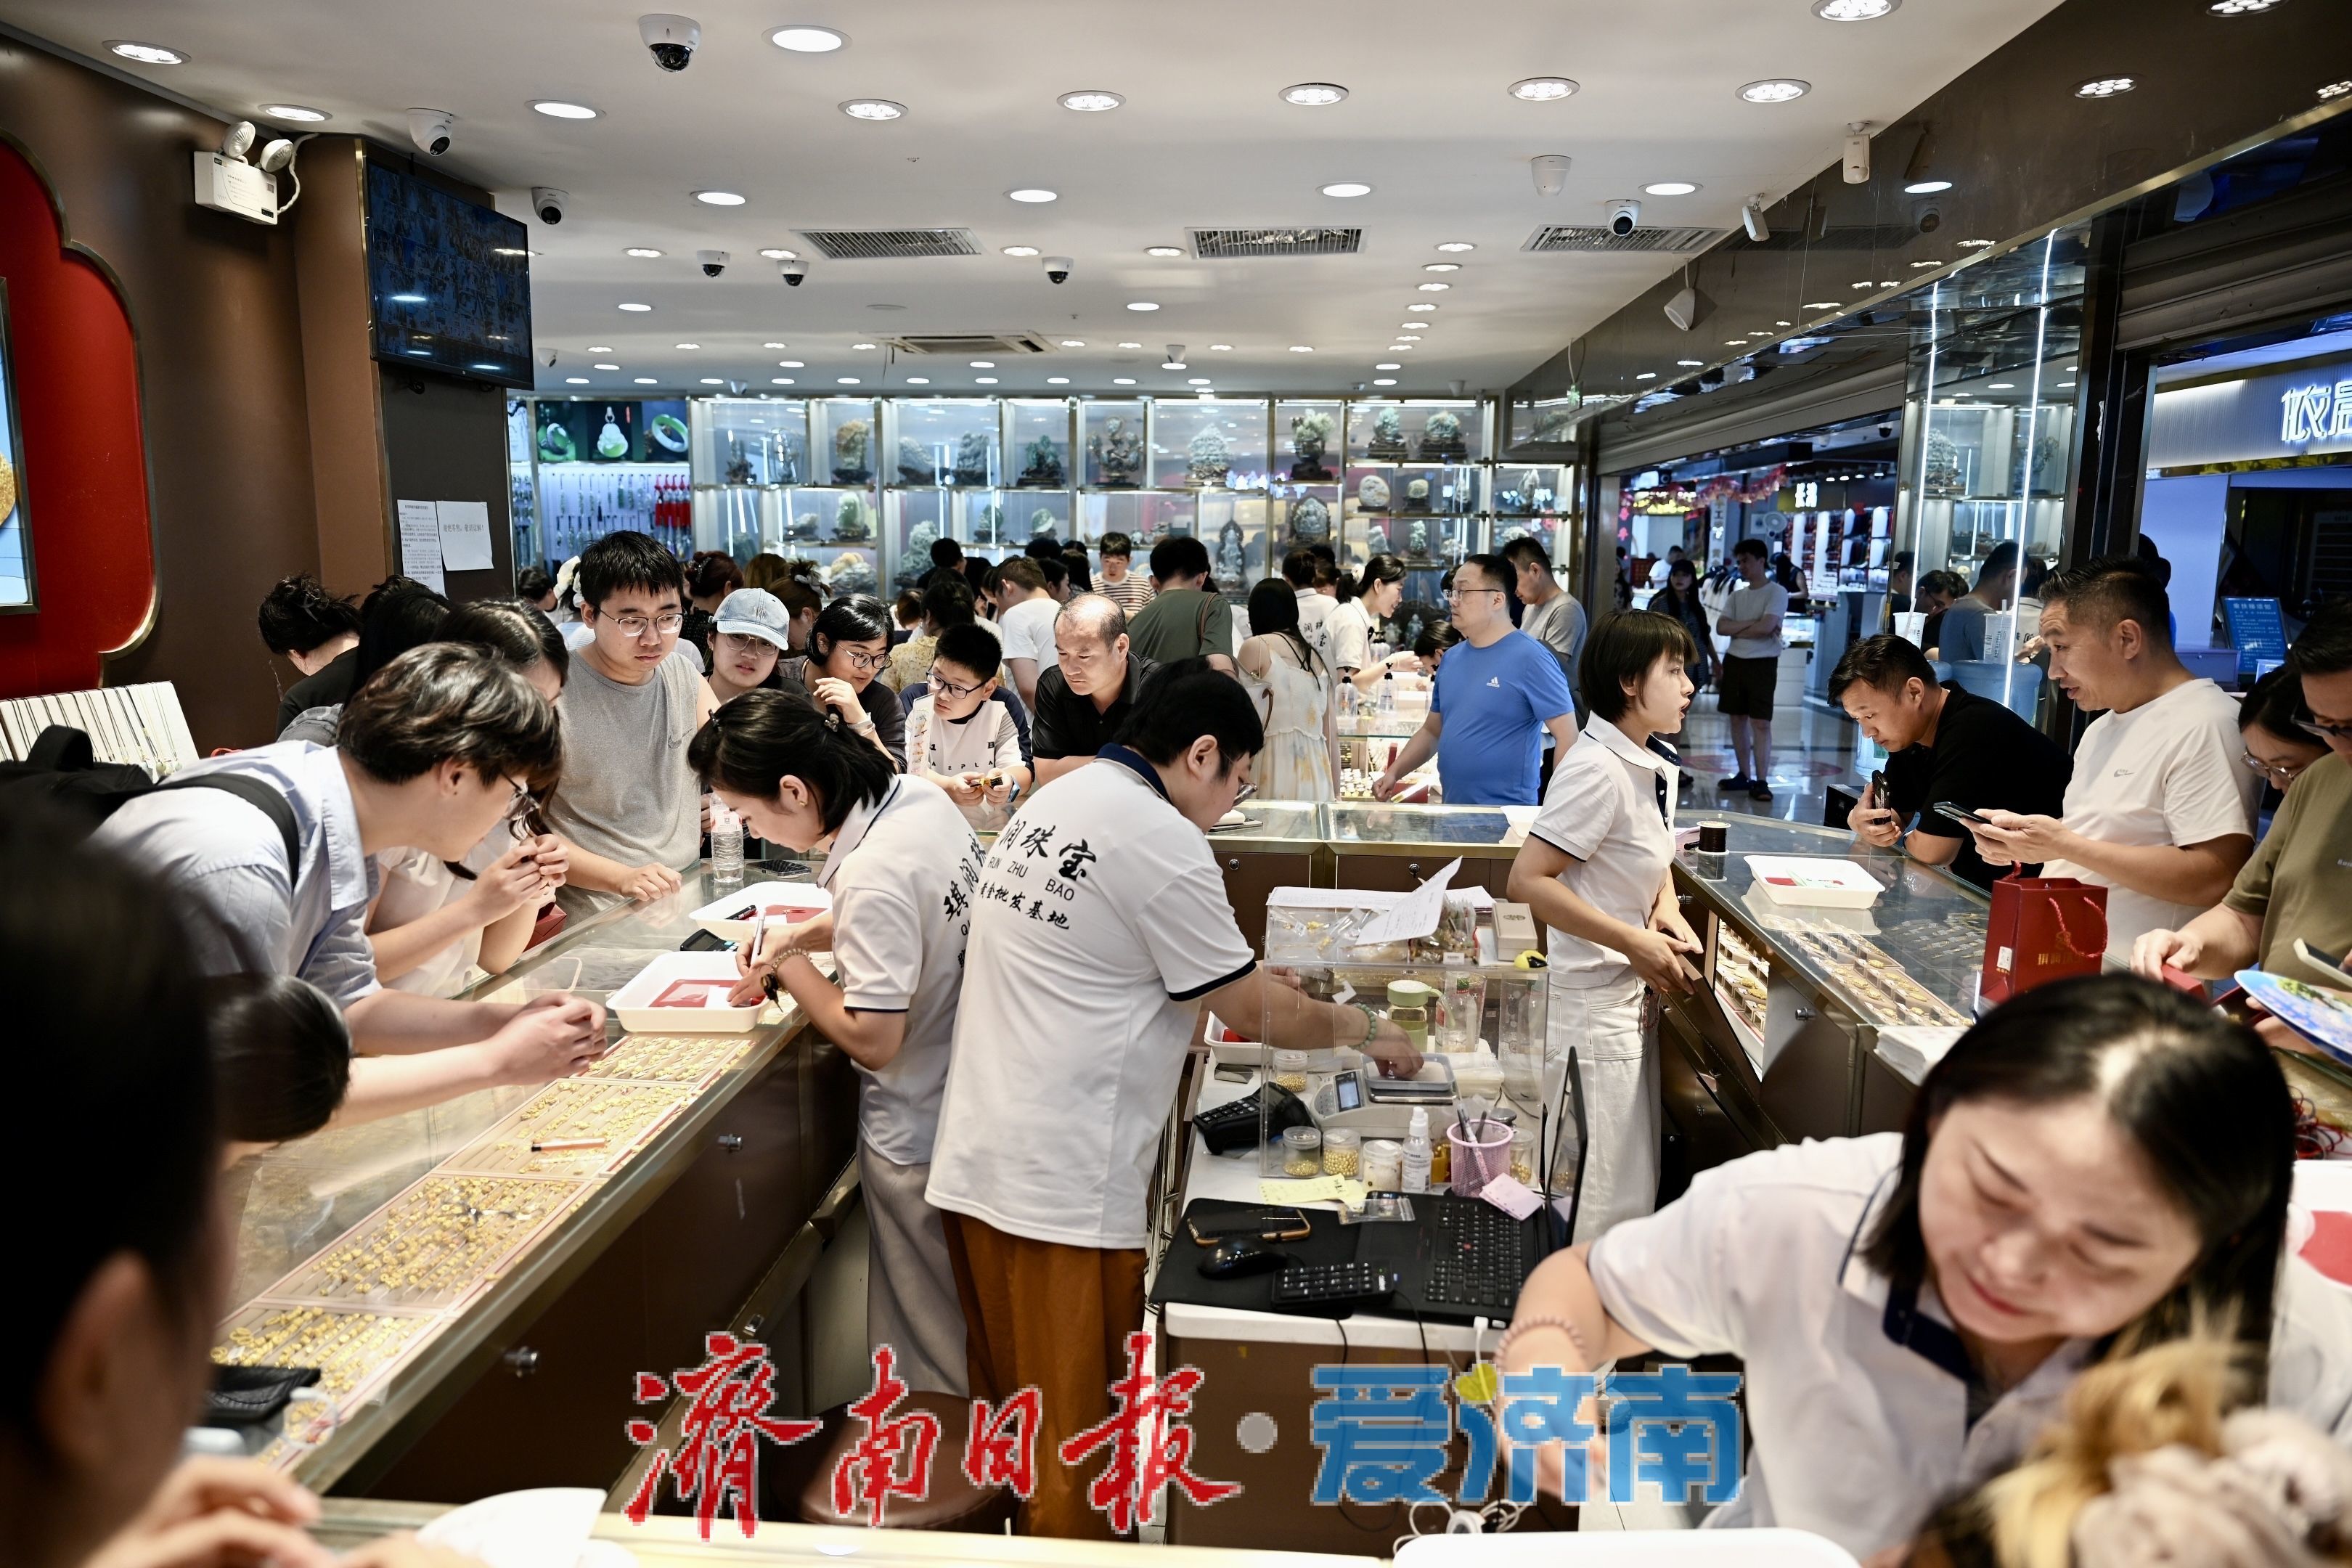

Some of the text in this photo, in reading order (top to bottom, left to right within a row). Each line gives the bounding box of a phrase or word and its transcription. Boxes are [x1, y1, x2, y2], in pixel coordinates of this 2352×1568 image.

[988, 857, 1074, 901] RUN ZHU BAO
